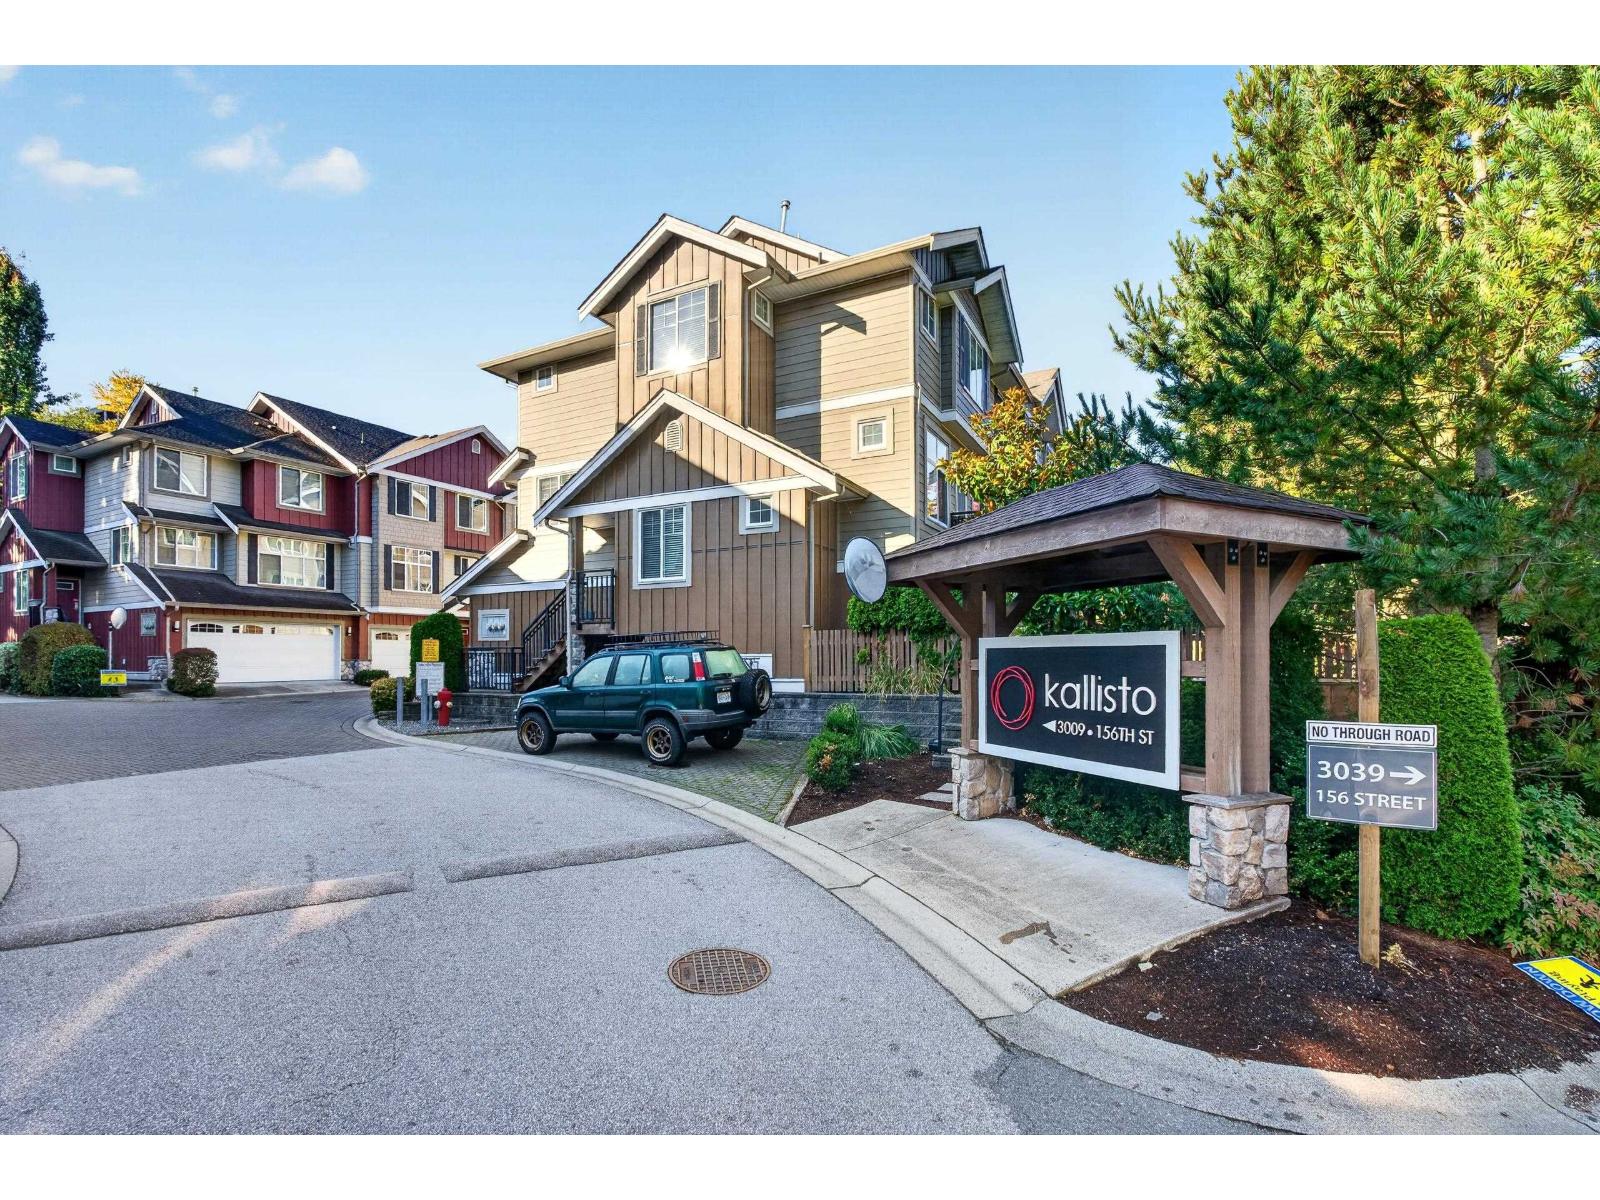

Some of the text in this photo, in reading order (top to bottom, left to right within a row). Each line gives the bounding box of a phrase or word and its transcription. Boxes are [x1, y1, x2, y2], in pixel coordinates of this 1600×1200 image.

[1044, 673, 1157, 716] kallisto
[1057, 720, 1155, 745] 3009 156TH ST
[1312, 726, 1431, 742] NO THROUGH ROAD
[1316, 760, 1385, 783] 3039
[1316, 789, 1427, 811] 156 STREET
